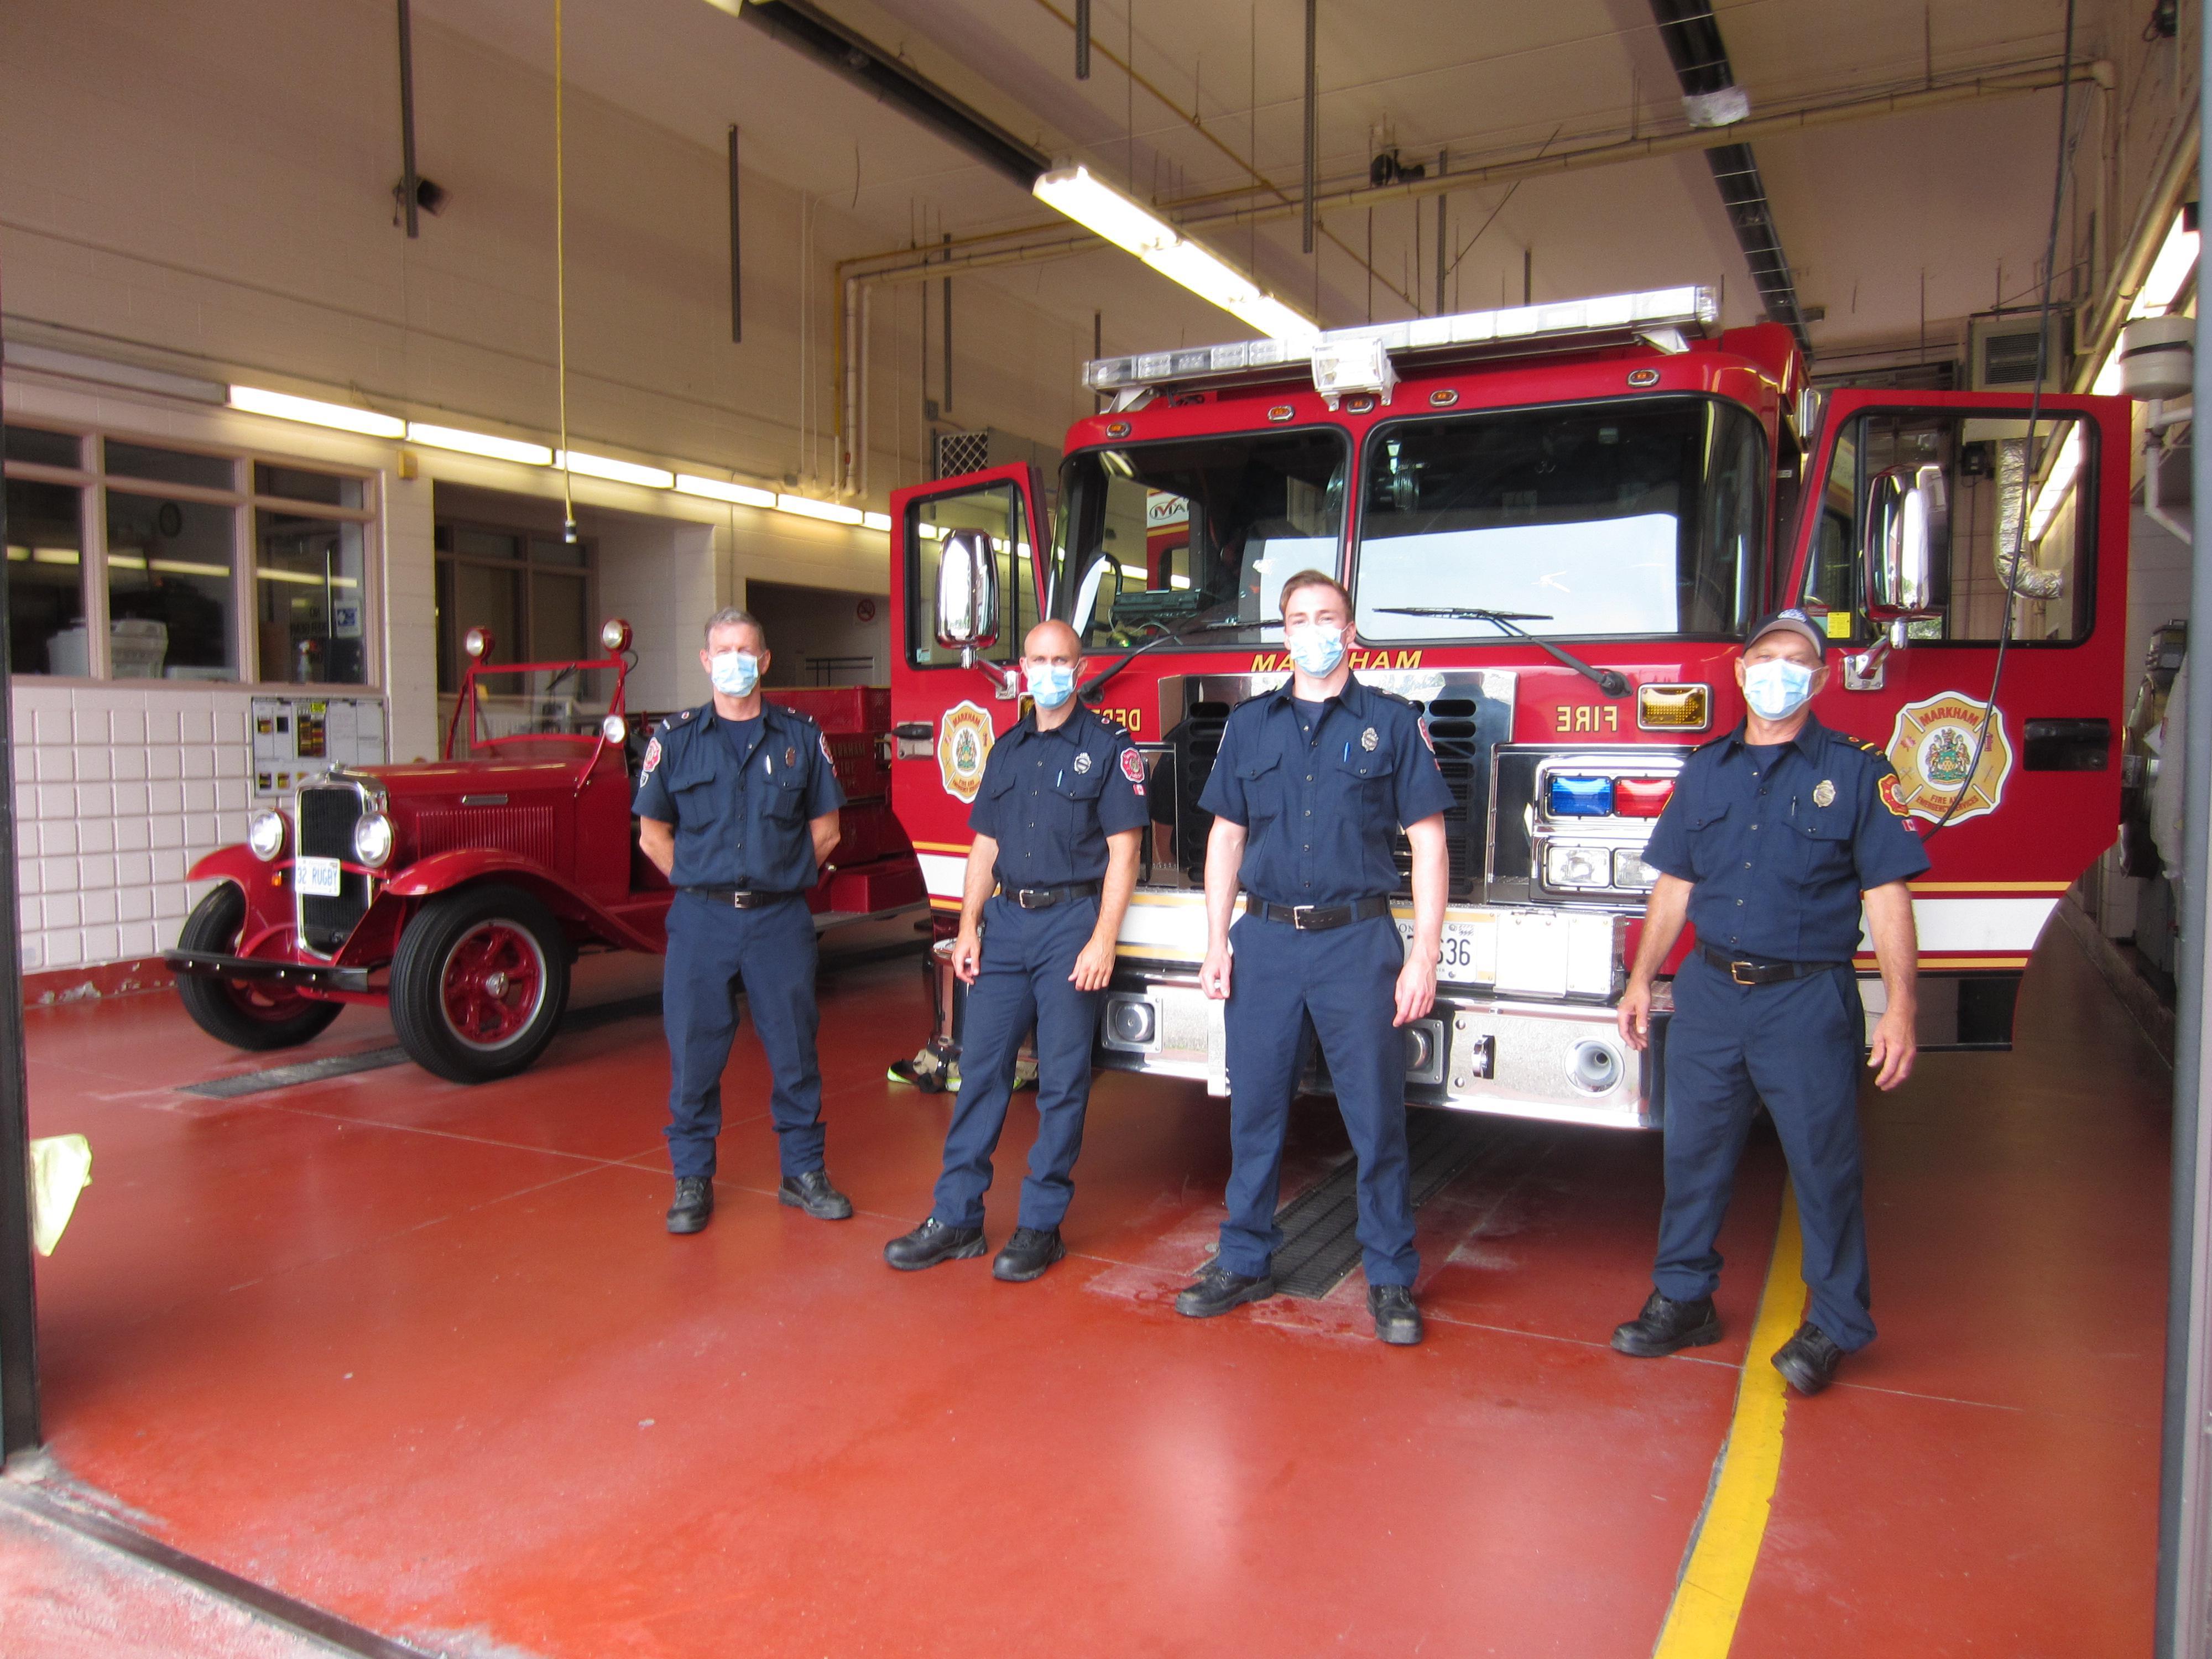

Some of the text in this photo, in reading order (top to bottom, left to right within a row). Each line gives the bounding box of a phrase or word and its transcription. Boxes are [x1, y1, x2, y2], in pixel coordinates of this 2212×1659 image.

[1250, 650, 1423, 673] MAHAM
[952, 712, 980, 728] MARKHAM
[1919, 707, 1979, 727] MARKHAM
[1931, 795, 1947, 804] FIRE
[298, 866, 337, 886] 32 RUGBY
